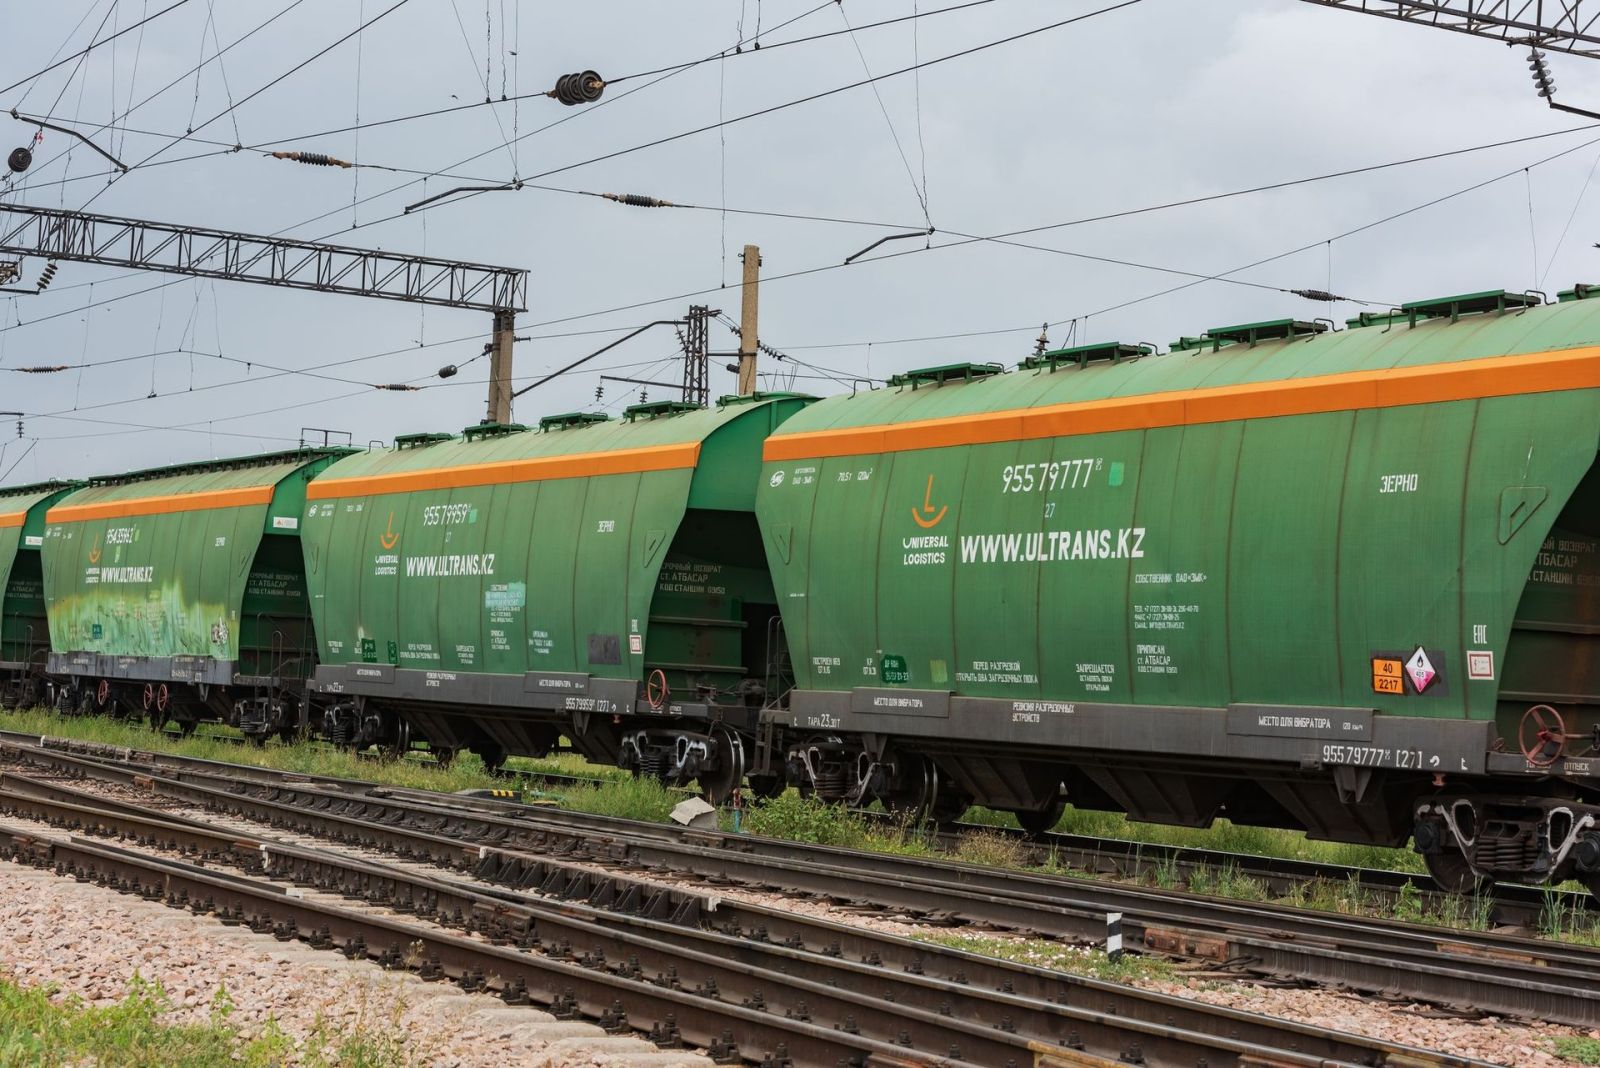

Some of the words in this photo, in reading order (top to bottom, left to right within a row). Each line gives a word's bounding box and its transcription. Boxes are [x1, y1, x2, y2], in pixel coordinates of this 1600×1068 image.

[1002, 458, 1094, 494] 95579777
[1379, 473, 1418, 493] ЗЕРНО
[423, 503, 468, 526] 95579959
[1044, 503, 1055, 518] 27
[903, 535, 949, 550] UNIVERSAL
[961, 527, 1146, 564] WWW.ULTRANS.KZ
[406, 553, 495, 577] WWW.ULTRANS.KZ
[903, 552, 946, 566] LOGISTICS
[1534, 552, 1577, 568] ТБАСАР
[101, 566, 154, 583] WWW.ULTRANS.KZ
[1145, 655, 1171, 665] АТБАСАР
[1075, 664, 1115, 674] ЗАПРЕЩАЕТСЯ
[1383, 663, 1393, 674] 40
[1379, 679, 1398, 691] 2217
[1258, 714, 1279, 726] МЕСТО
[1280, 716, 1293, 727] ДЛЯ
[1294, 717, 1331, 729] ВИБРАТОРА
[1322, 744, 1385, 766] 95579777
[1563, 761, 1590, 771] ОТПУСК
